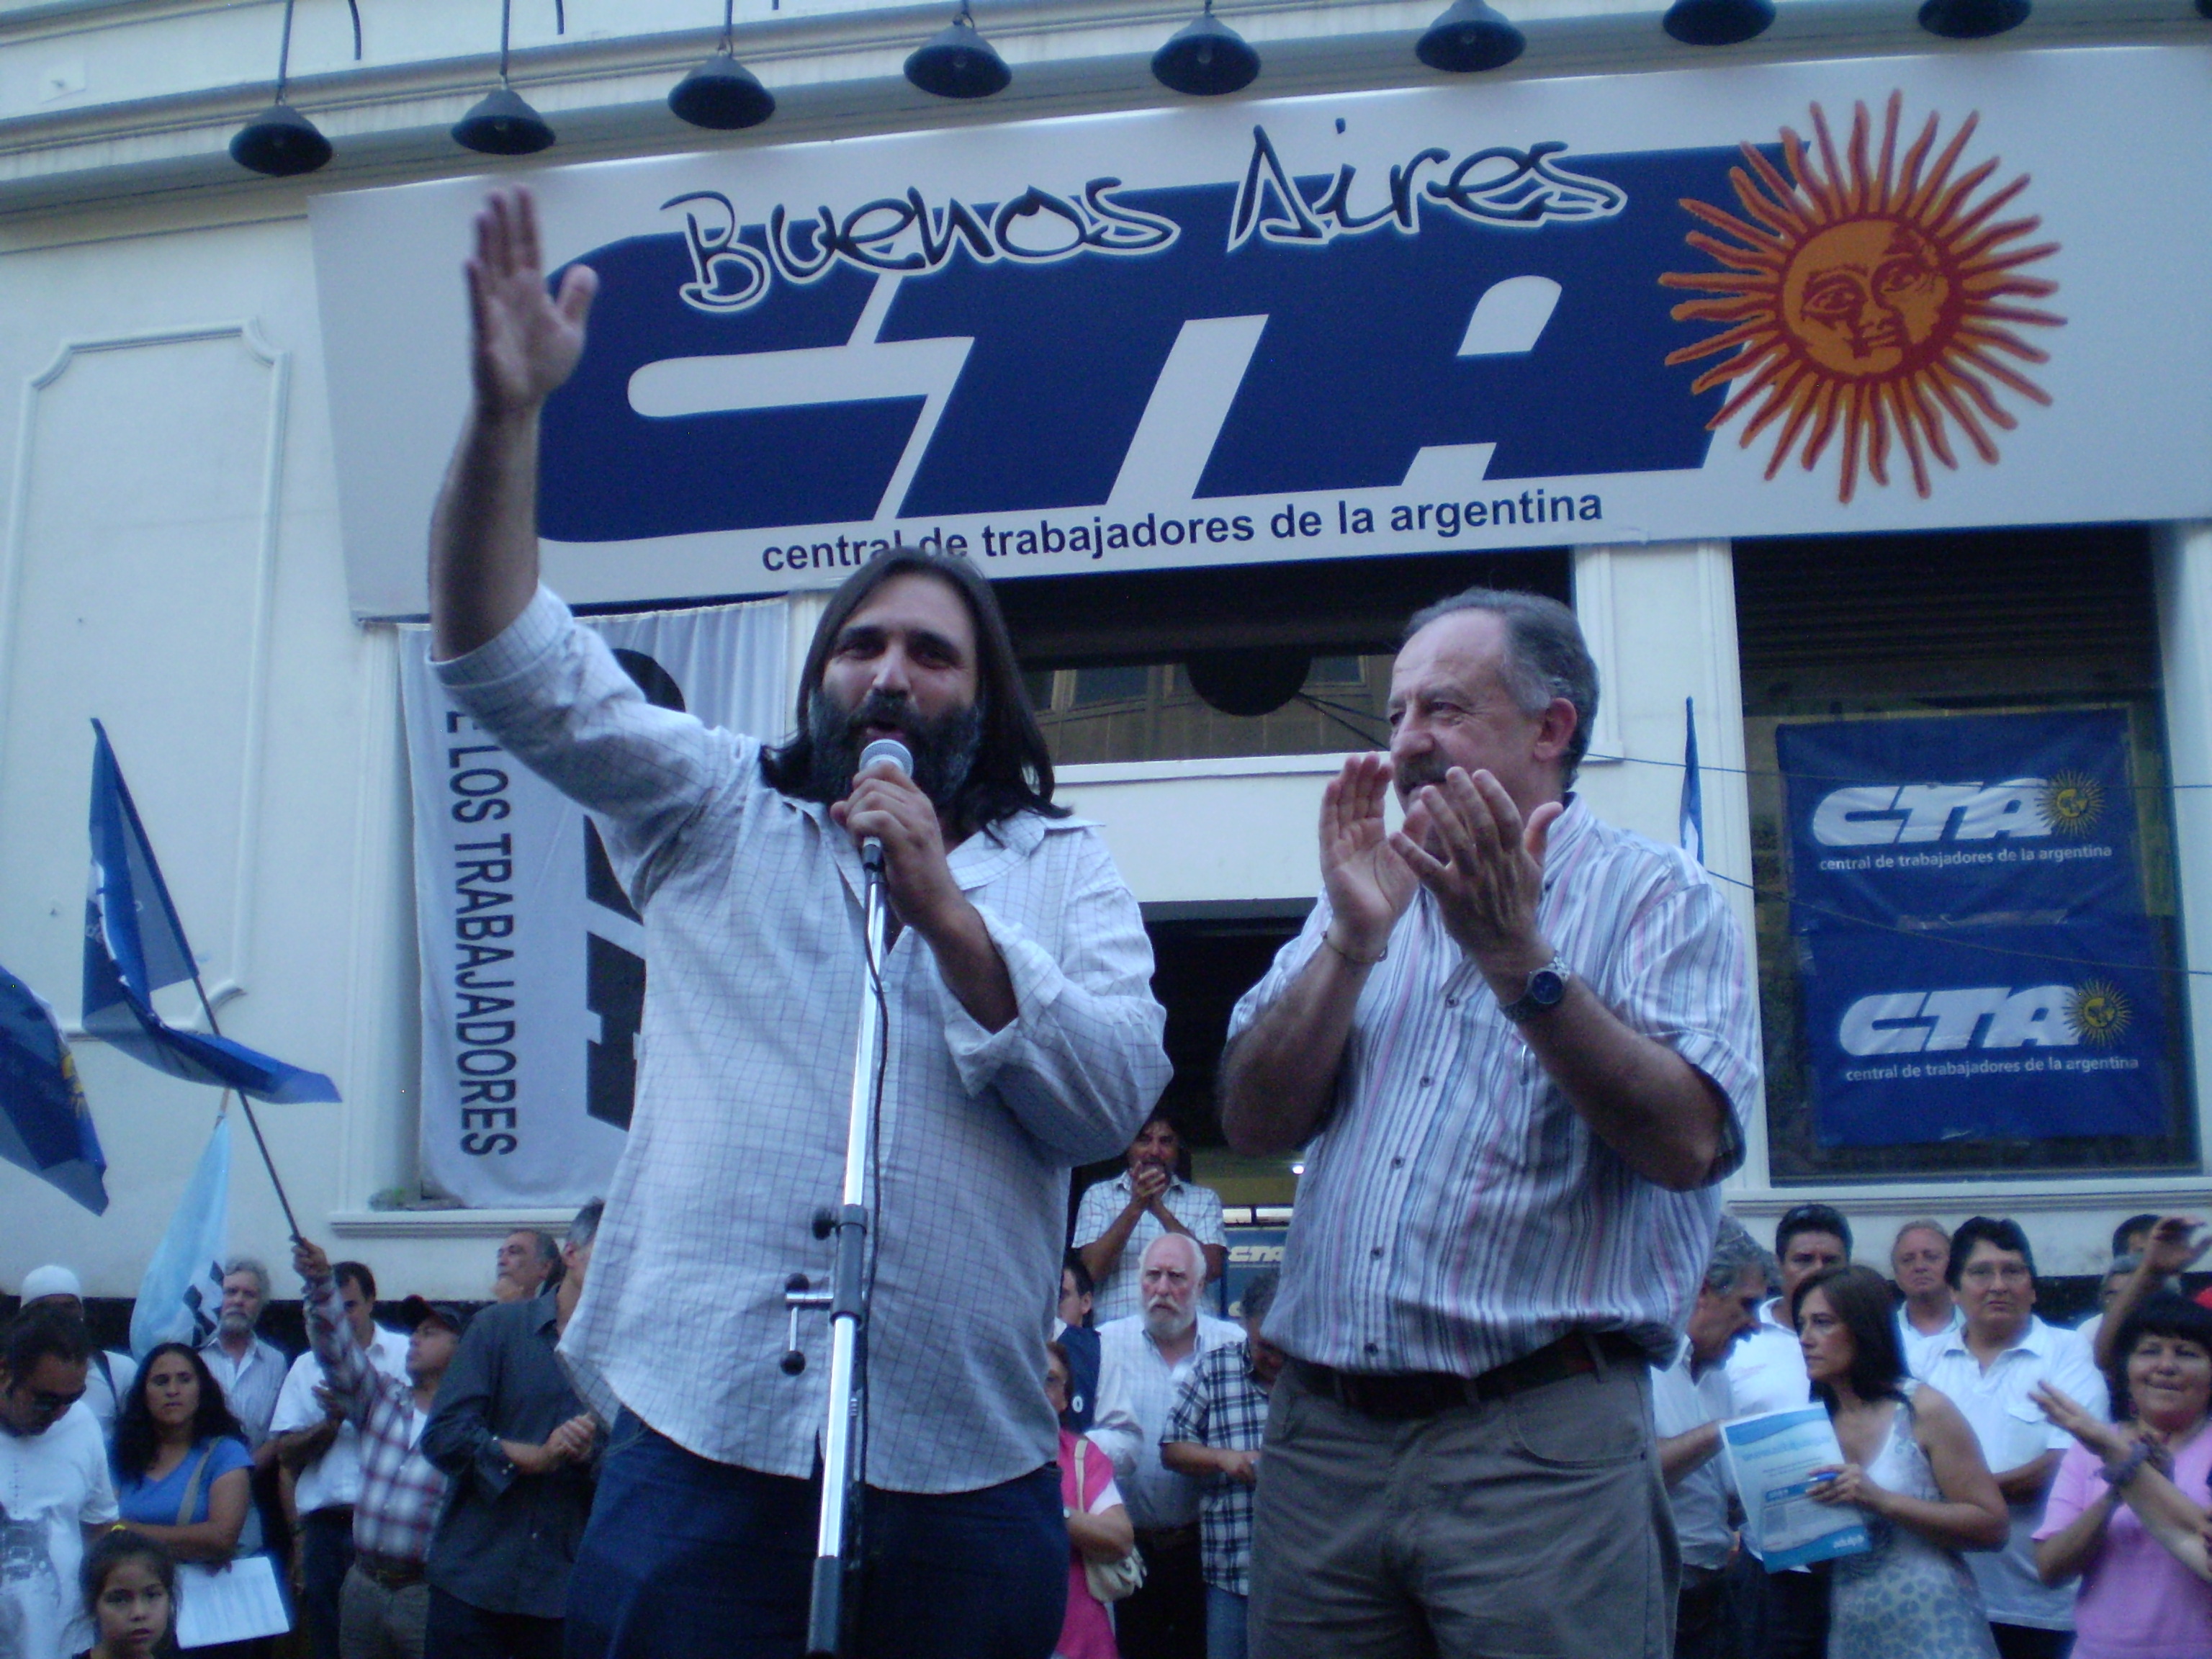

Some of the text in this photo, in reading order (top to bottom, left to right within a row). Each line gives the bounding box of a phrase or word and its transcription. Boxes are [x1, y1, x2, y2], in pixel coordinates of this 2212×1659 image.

[660, 117, 1627, 313] Buenos Aires
[536, 142, 1807, 544] CTA
[981, 513, 1255, 559] trabajadores
[1271, 504, 1322, 539] de
[1339, 500, 1374, 535] la
[1390, 489, 1603, 537] argentina
[449, 745, 511, 823] LOS
[1813, 777, 2055, 846] CTA
[1820, 844, 2113, 871] central de trabajadores de la argentina
[454, 833, 518, 1157] TRABAJADORES
[1839, 984, 2082, 1056] CTA
[1845, 1055, 2139, 1082] central de trabajadores de la argentina
